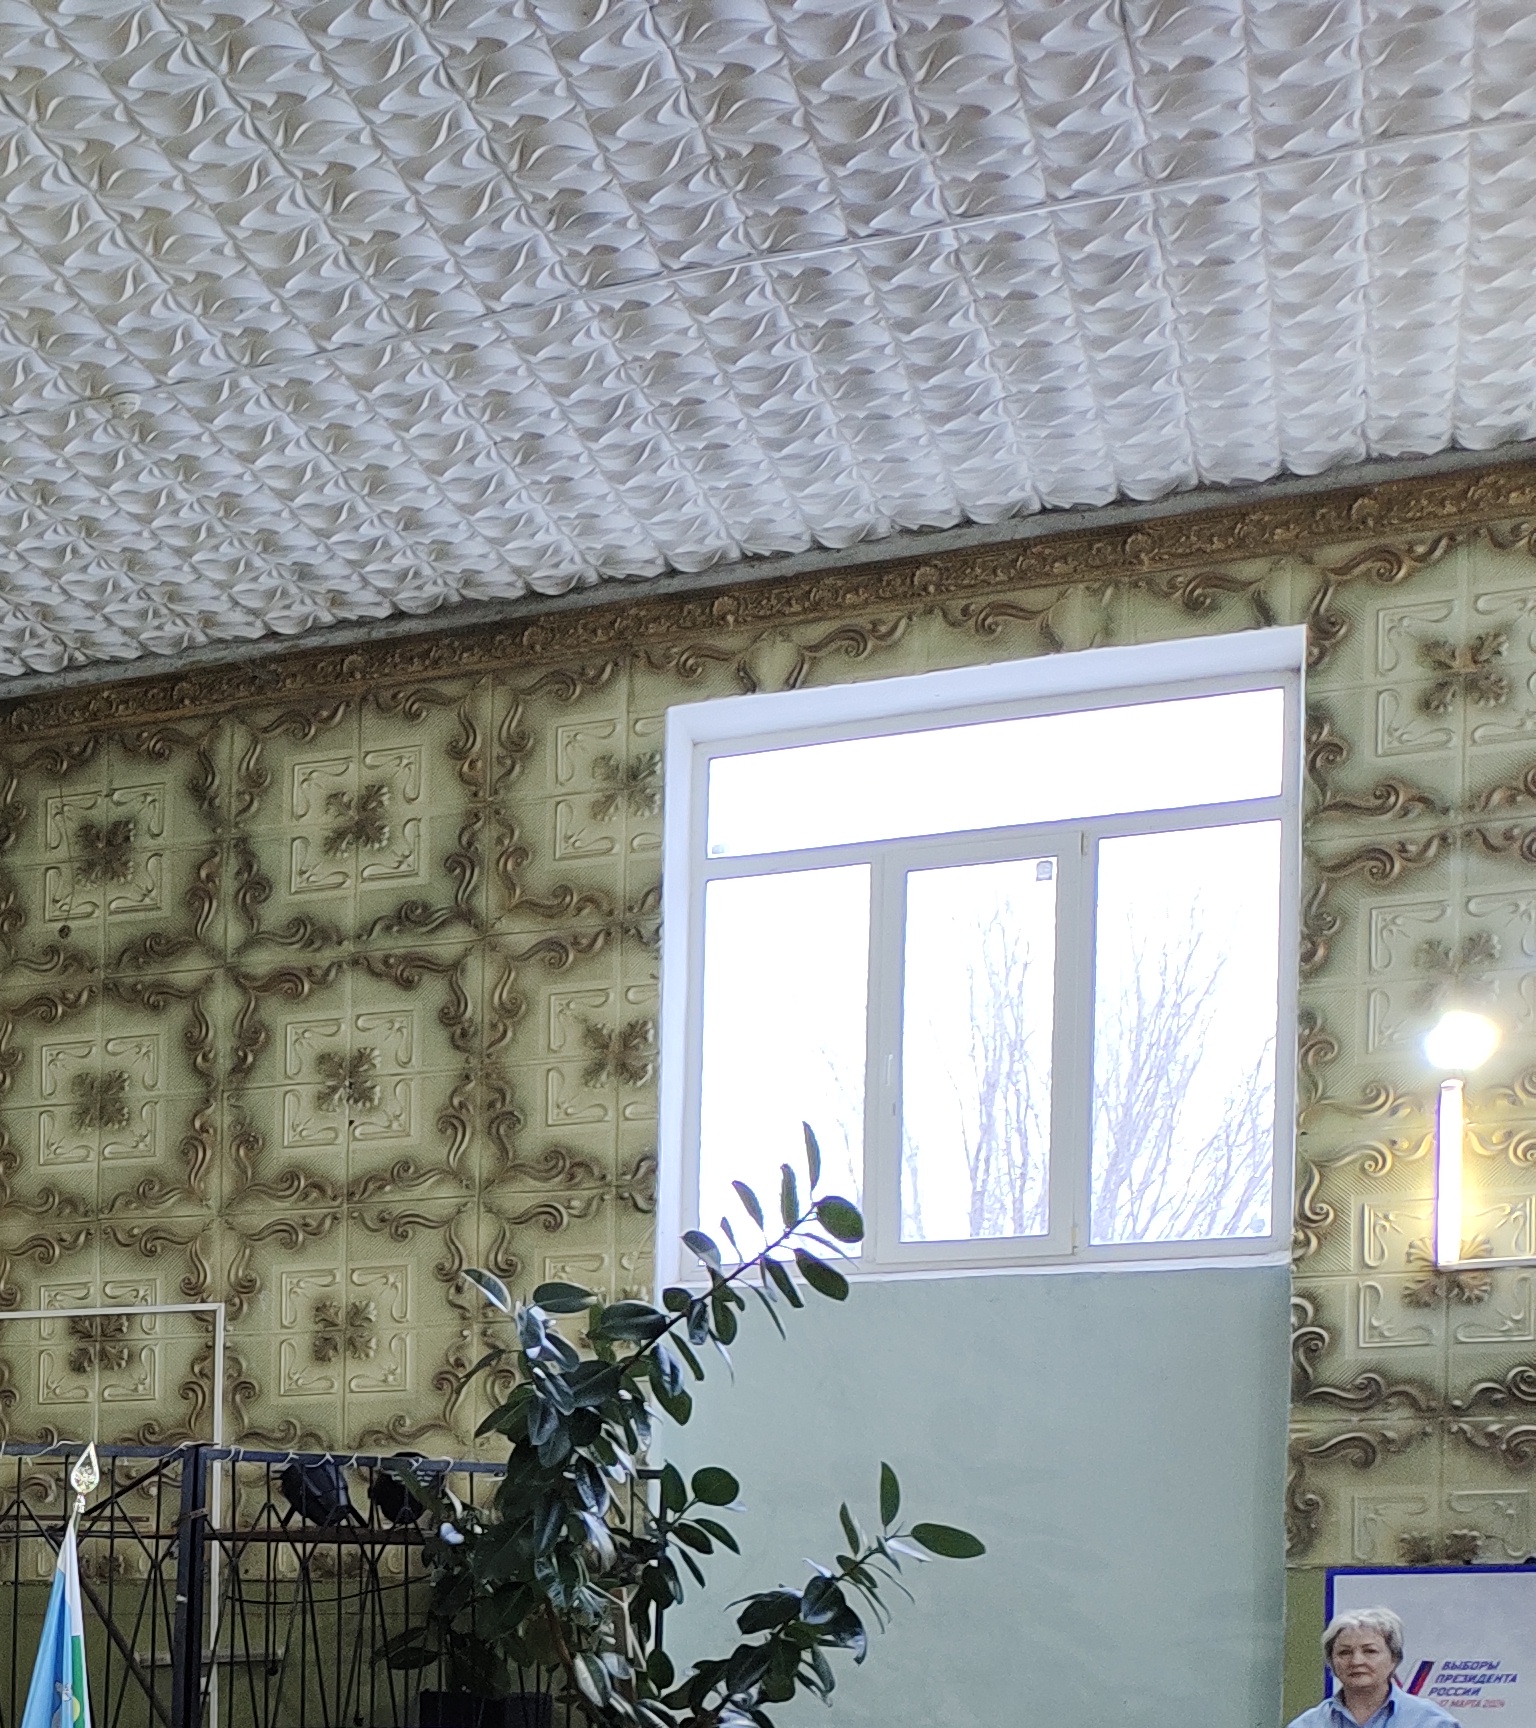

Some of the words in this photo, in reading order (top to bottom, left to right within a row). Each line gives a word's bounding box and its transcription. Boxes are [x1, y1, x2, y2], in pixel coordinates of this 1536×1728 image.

[1441, 1660, 1502, 1671] ВЫБОРЫ
[1434, 1673, 1519, 1685] ПРЕЗИДЕНТА
[1428, 1687, 1482, 1697] РОССИИ
